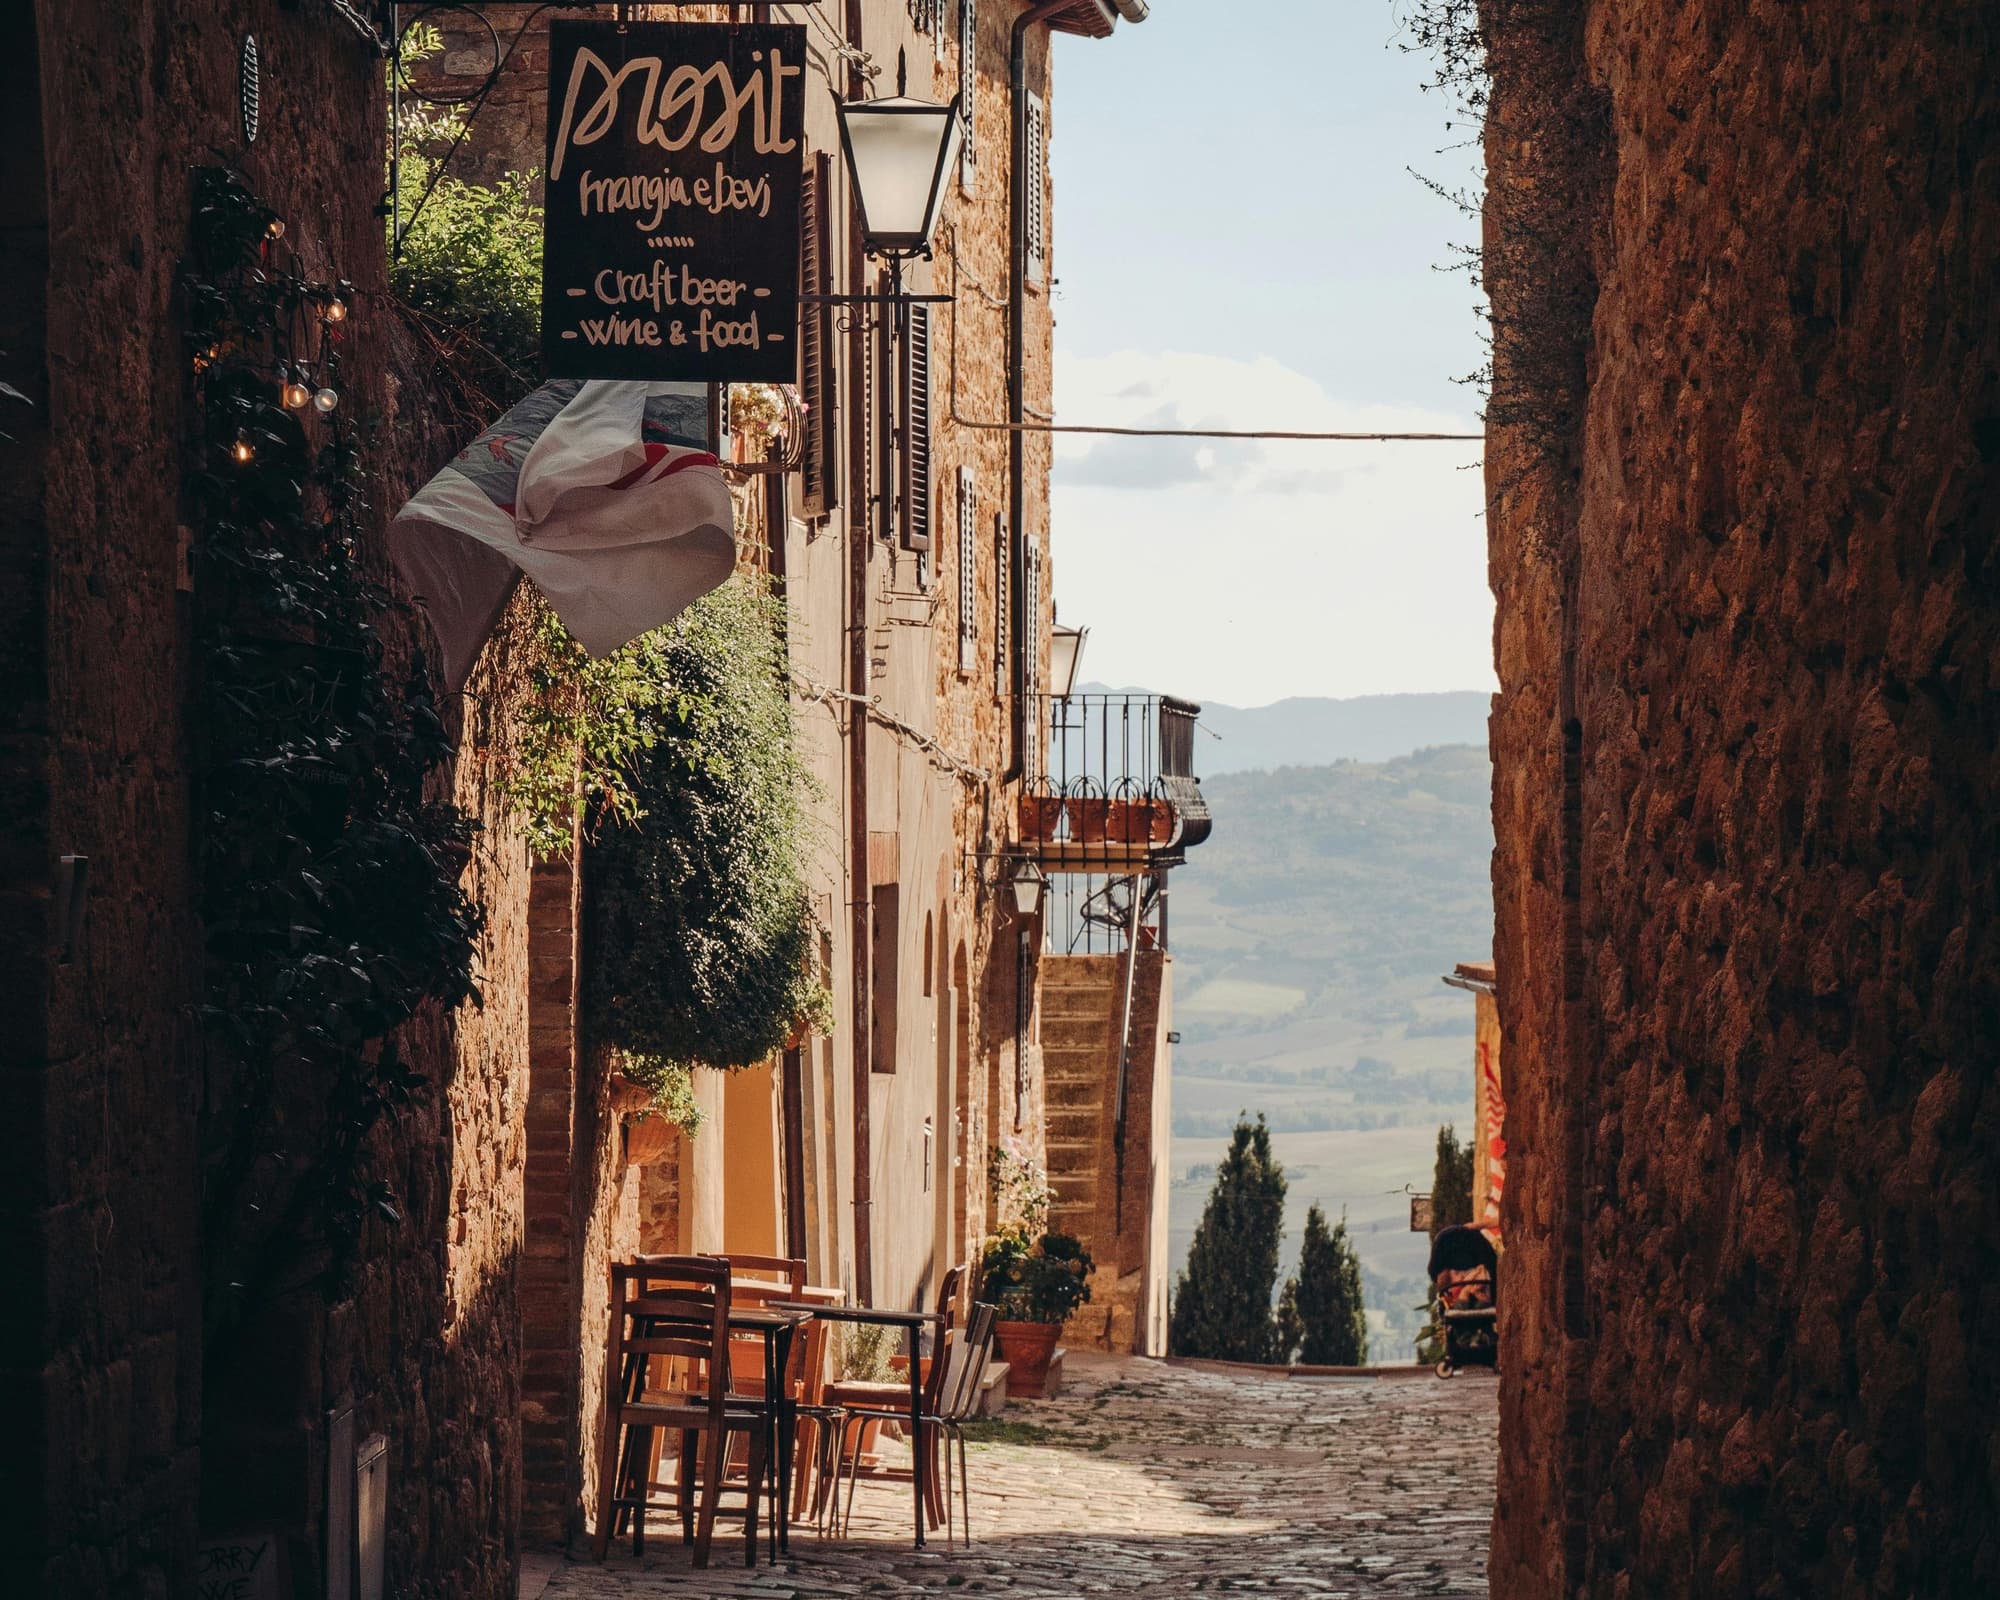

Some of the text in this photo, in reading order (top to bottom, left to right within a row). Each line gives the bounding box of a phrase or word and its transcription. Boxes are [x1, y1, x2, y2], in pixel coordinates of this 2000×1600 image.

[580, 168, 691, 232] mangia
[682, 264, 747, 306] beer
[580, 309, 760, 353] wine & food
